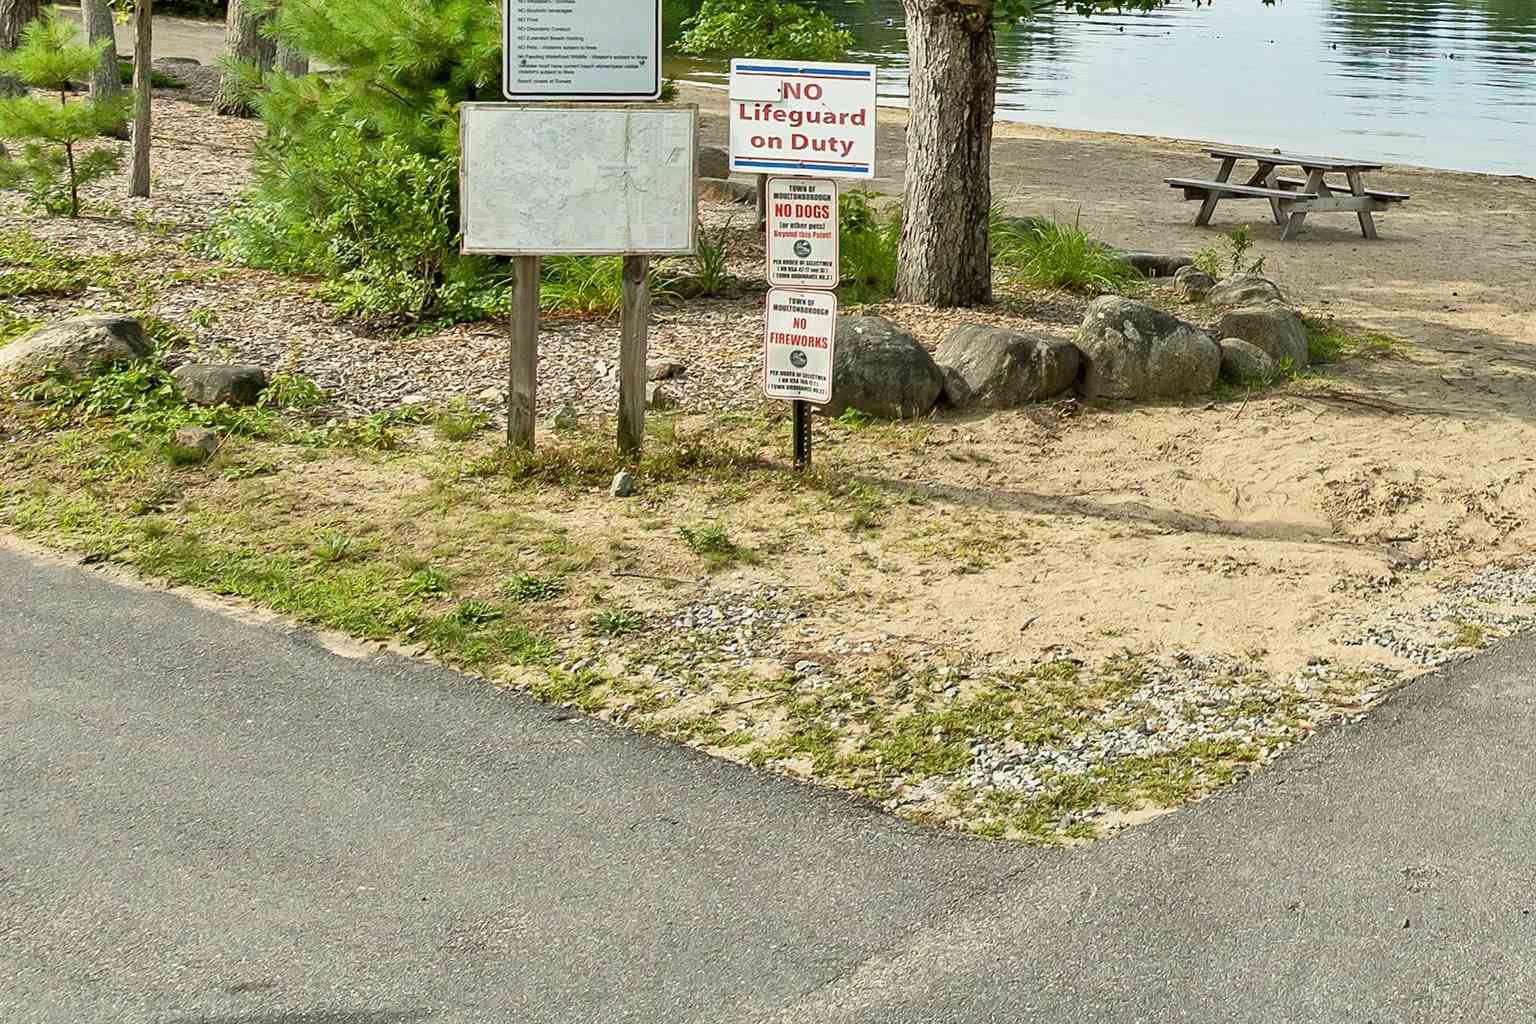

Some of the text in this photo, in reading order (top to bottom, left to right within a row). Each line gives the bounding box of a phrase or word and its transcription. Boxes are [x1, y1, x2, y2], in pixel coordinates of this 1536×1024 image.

[783, 82, 823, 101] NO
[739, 103, 867, 128] Lifeguard
[751, 134, 855, 158] on Duty
[789, 185, 807, 193] TOWN
[773, 193, 832, 202] MOULTONBOROUGH
[775, 204, 830, 219] NO DOGS
[774, 230, 798, 238] Beyond
[789, 297, 807, 305] TOWN
[773, 304, 830, 316] MOULTONBOROUGH
[793, 317, 807, 330] NO
[770, 332, 829, 350] FIREWORKS
